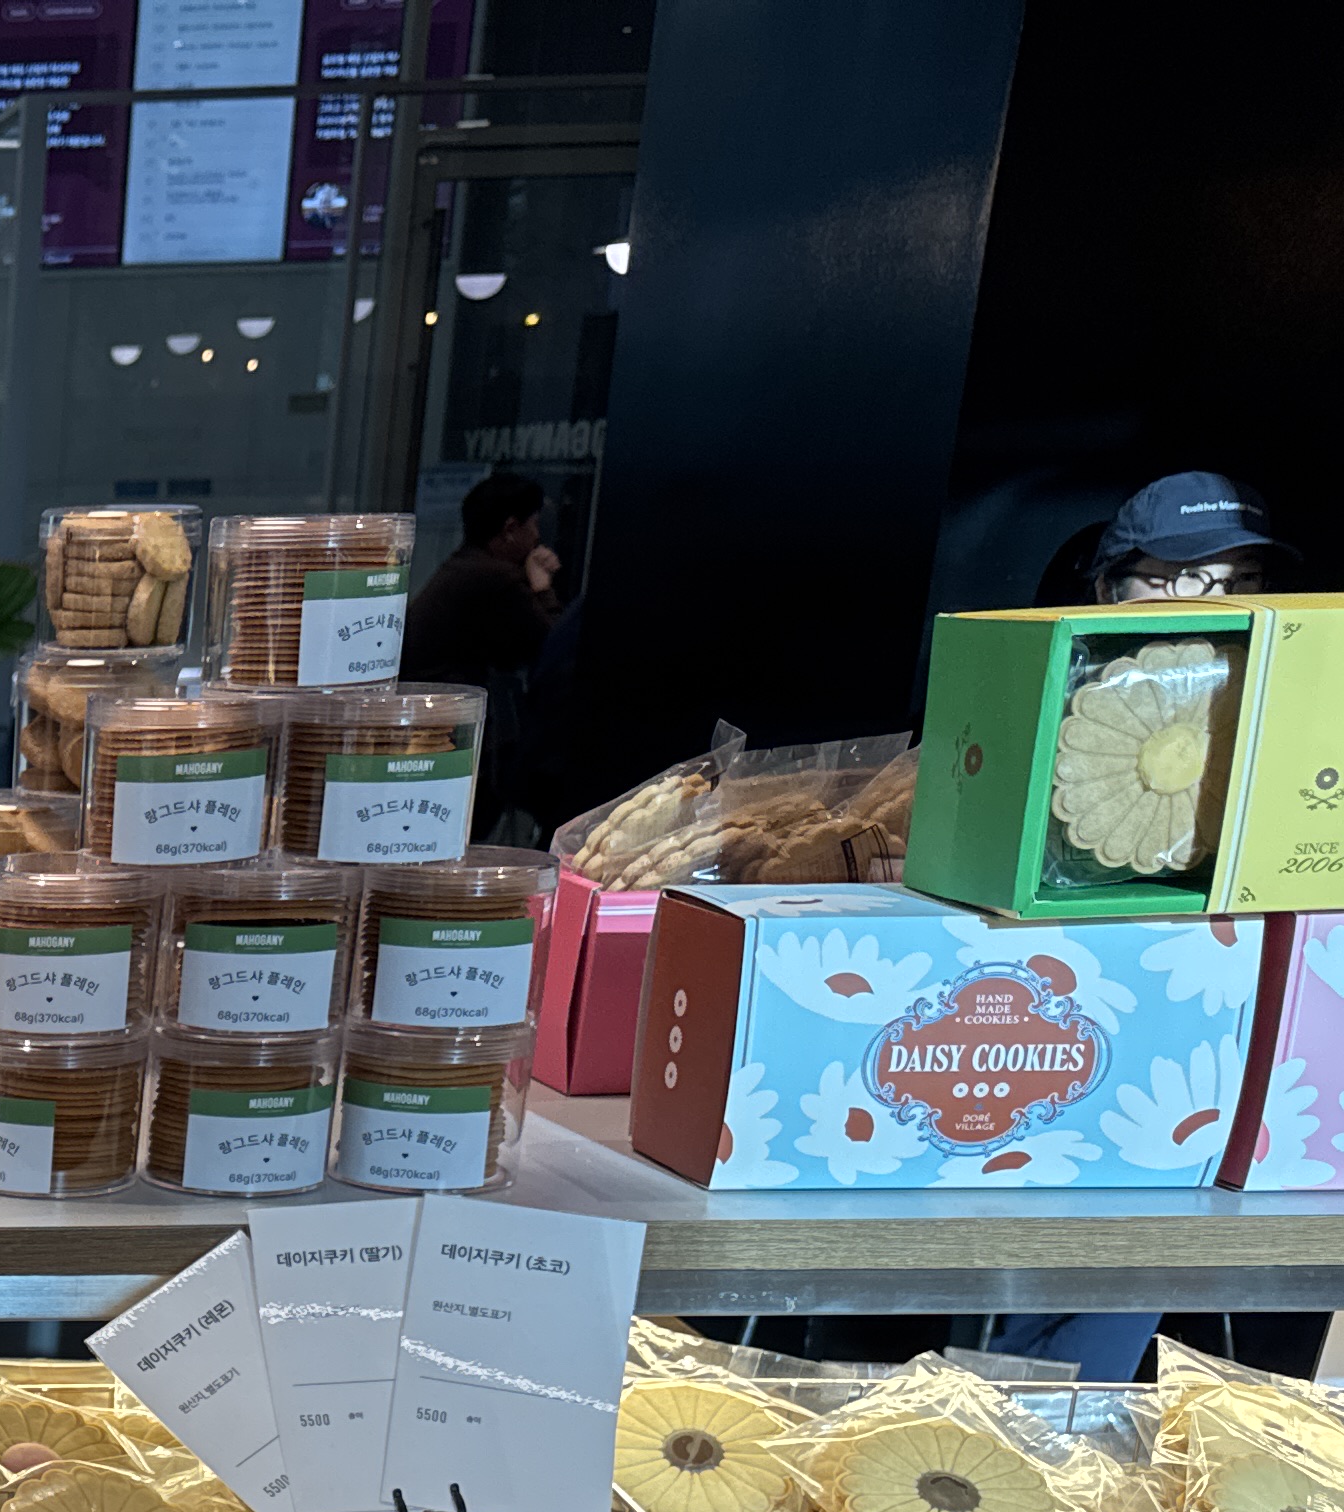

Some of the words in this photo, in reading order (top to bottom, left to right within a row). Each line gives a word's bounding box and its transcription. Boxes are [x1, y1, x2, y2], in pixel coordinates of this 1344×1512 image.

[337, 613, 385, 641] 랑그드샤
[144, 799, 201, 824] 랑그드샤
[204, 801, 242, 823] 플레인
[356, 798, 413, 823] 랑그드샤
[417, 800, 452, 823] 플레인
[1294, 842, 1340, 855] SINCE
[1278, 856, 1344, 874] 2006
[5, 972, 56, 992] 랑그드샤
[61, 972, 100, 997] 플레인
[208, 969, 263, 991] 랑그드샤
[267, 971, 306, 995] 플레인
[404, 965, 462, 987] 랑그드샤
[465, 966, 505, 989] 플레인
[975, 1005, 1011, 1014] MADE
[976, 994, 1014, 1004] HAND
[964, 1015, 1020, 1025] COOKIES
[888, 1044, 966, 1073] DAISY
[972, 1043, 1085, 1073] COOKIES
[955, 1122, 996, 1131] VILLAGE
[218, 1134, 274, 1155] 랑그드샤
[277, 1133, 311, 1154] 플레인
[362, 1128, 412, 1146] 랑그드샤
[416, 1130, 457, 1155] 플레인
[276, 1247, 354, 1268] 데이지쿠키
[359, 1245, 403, 1264] (딸기)
[440, 1243, 521, 1270] 데이지쿠키
[525, 1255, 571, 1276] (초코)
[136, 1323, 201, 1373] 데이지쿠키
[197, 1299, 235, 1330] (레몬)
[299, 1413, 330, 1427] 5500
[416, 1407, 448, 1424] 5500
